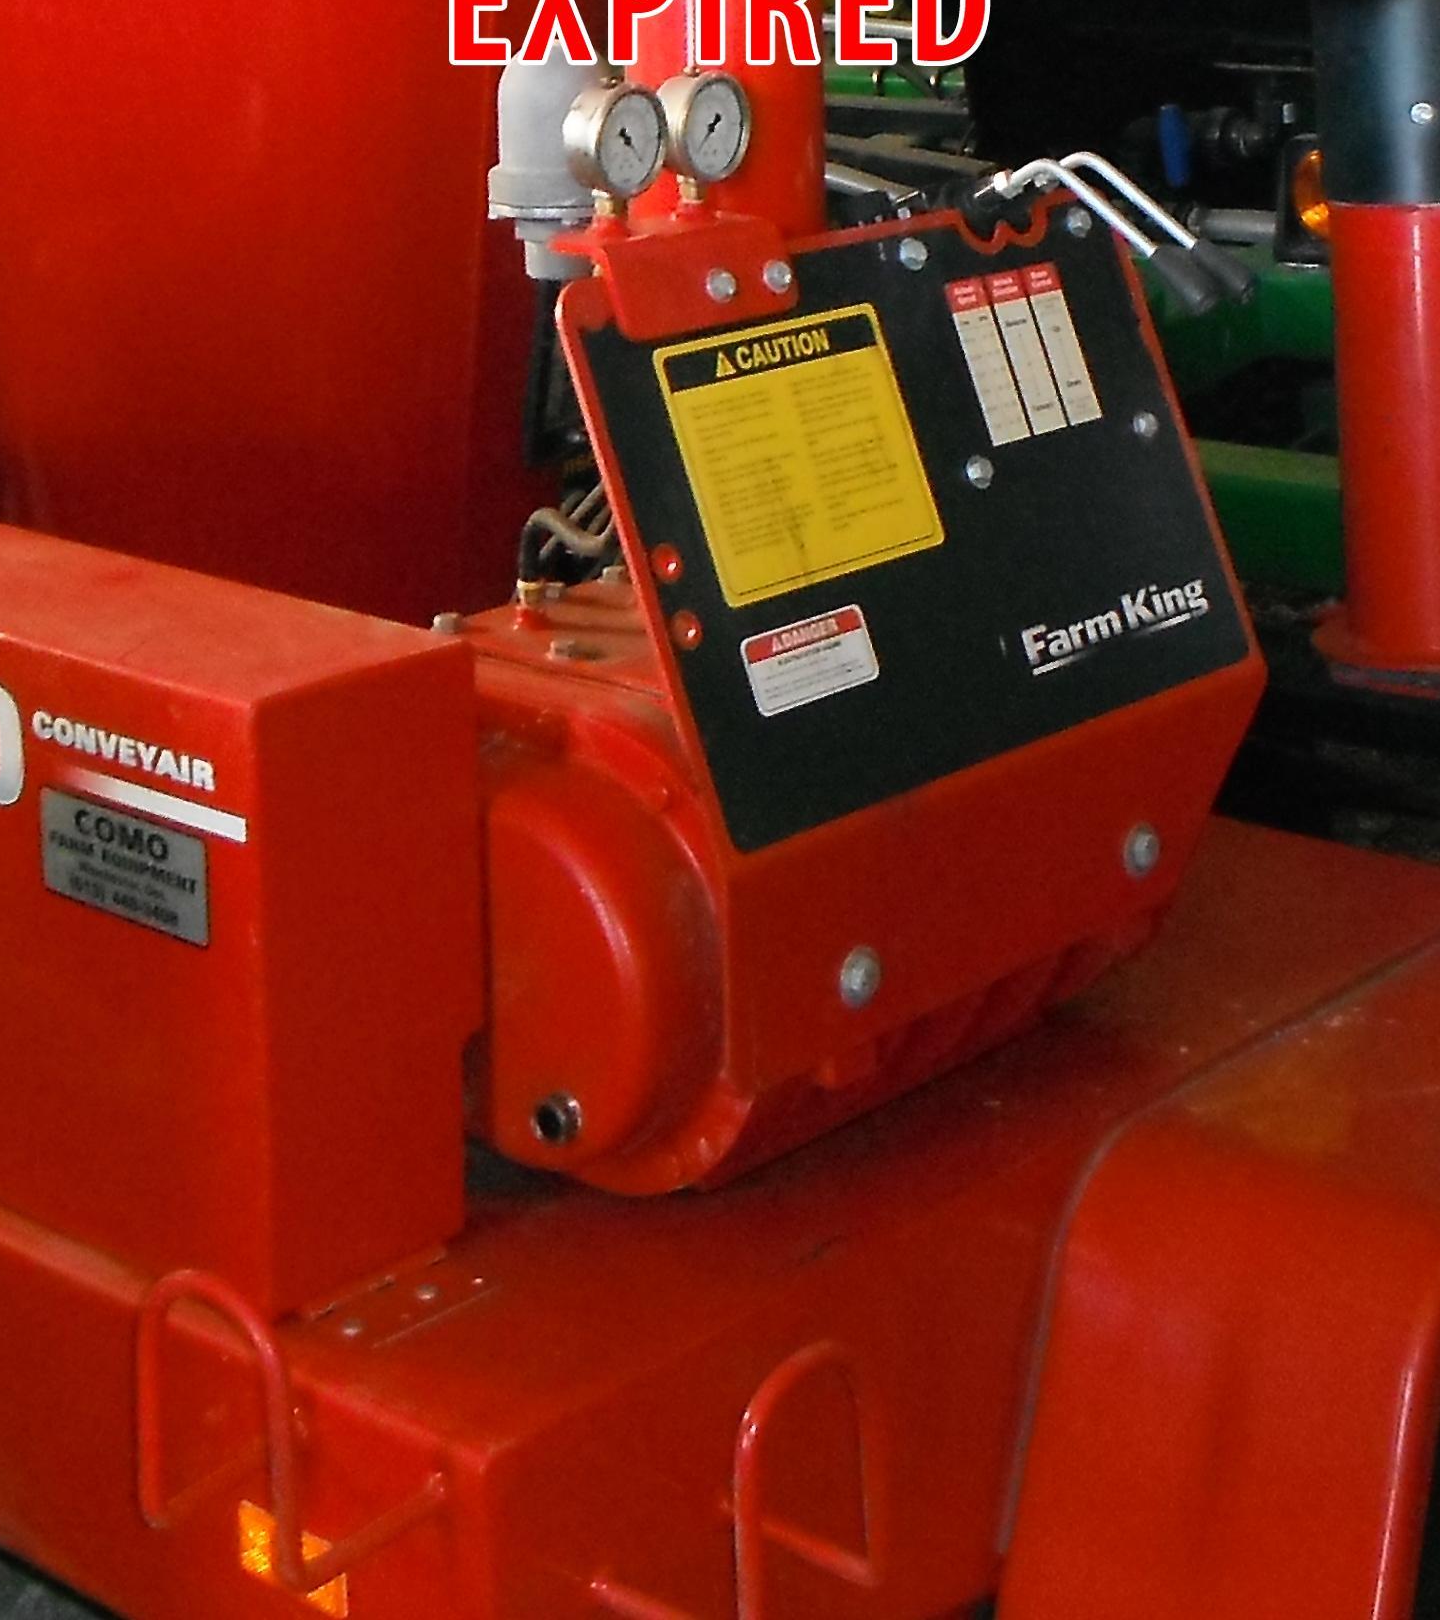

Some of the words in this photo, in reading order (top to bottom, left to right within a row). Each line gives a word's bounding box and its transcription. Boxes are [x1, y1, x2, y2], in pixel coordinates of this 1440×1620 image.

[735, 328, 831, 370] CAUTION
[780, 617, 840, 649] DANGER
[1021, 609, 1123, 666] Farm
[1120, 578, 1210, 630] King
[32, 710, 216, 792] CONVEYAIR
[74, 808, 169, 862] COMO
